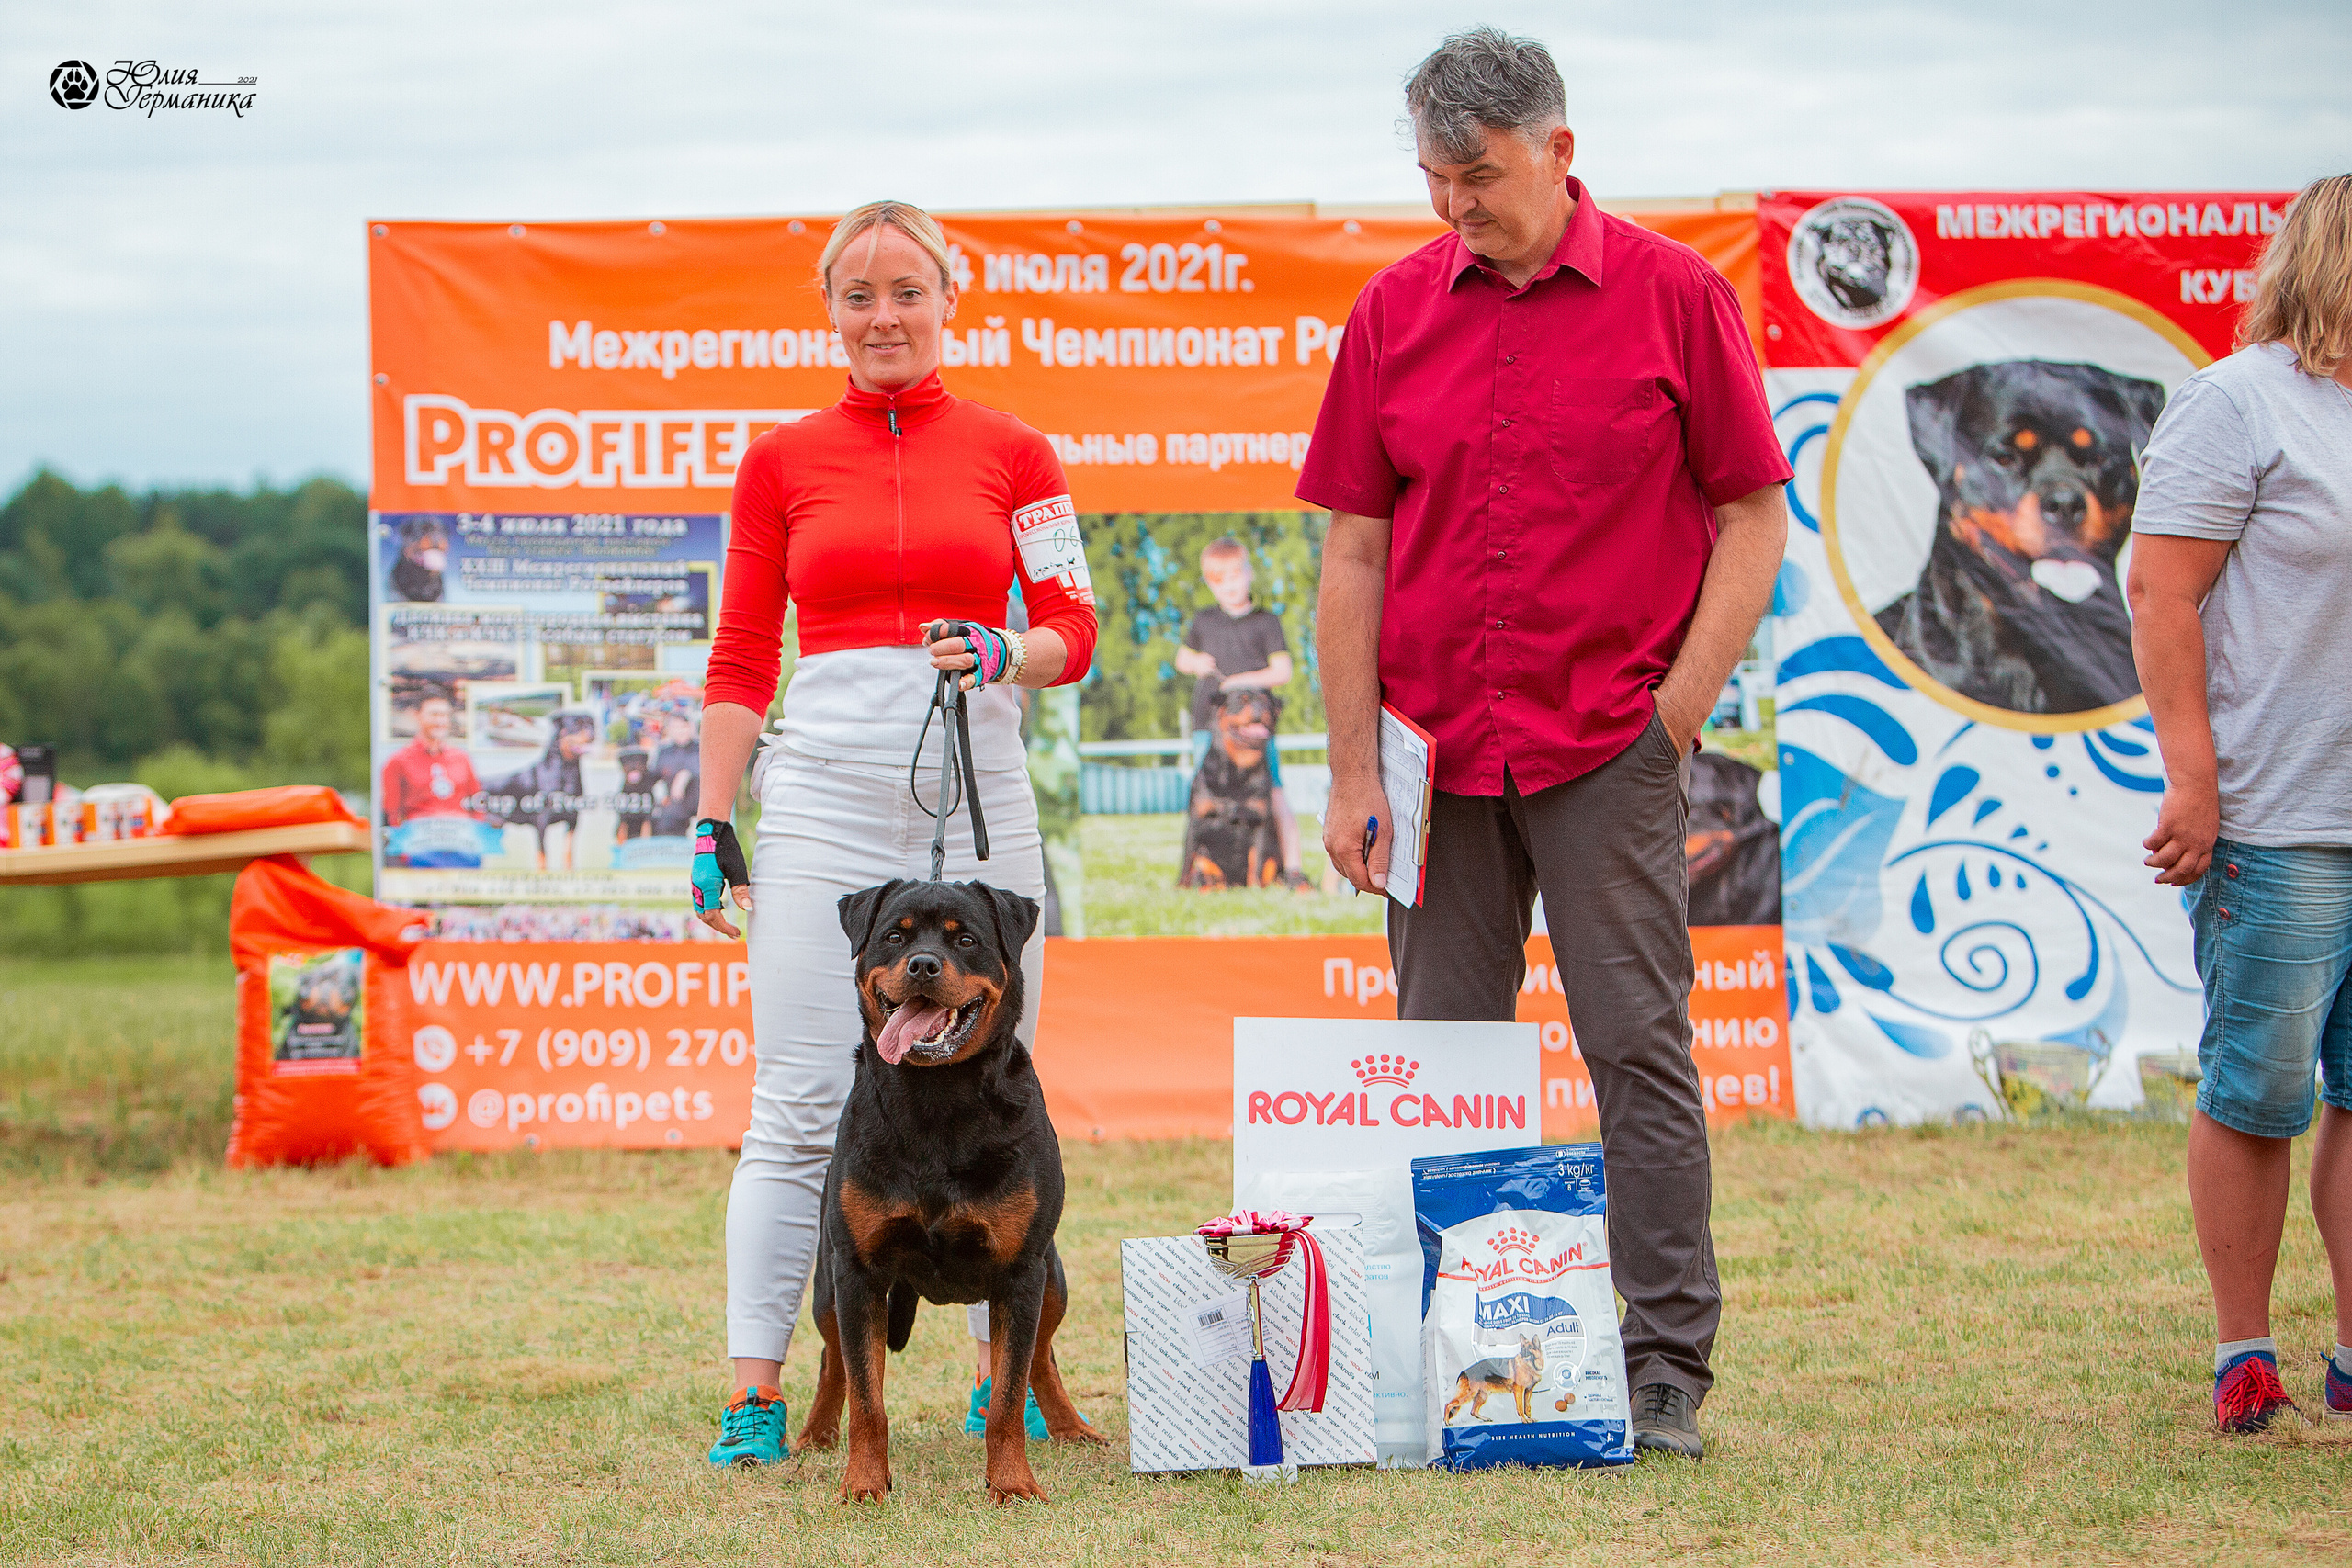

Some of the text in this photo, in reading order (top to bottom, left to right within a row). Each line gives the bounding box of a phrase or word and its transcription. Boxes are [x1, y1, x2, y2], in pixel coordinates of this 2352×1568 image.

[984, 253, 1108, 293] июля
[1120, 243, 1255, 292] 2021г.
[1022, 317, 1284, 367] Чемпионат
[571, 513, 627, 536] 2021
[465, 1027, 522, 1066] +7
[537, 1026, 651, 1072] (909)
[467, 1081, 715, 1132] @profipets
[1249, 1090, 1526, 1130] ROYAL CANIN
[1154, 1251, 1174, 1269] orologio
[1519, 1242, 1583, 1276] CANIN
[1338, 1271, 1359, 1289] orologio
[1120, 1285, 1142, 1303] orologio
[1479, 1295, 1530, 1321] MAXI
[1546, 1321, 1579, 1337] Adult
[1169, 1341, 1190, 1360] orologio
[1274, 1339, 1295, 1359] orologio
[1136, 1375, 1158, 1394] orologio
[1329, 1371, 1350, 1390] orologio
[1210, 1408, 1230, 1427] orologio
[1538, 1431, 1576, 1439] NUTRITION
[1178, 1443, 1198, 1461] orologio
